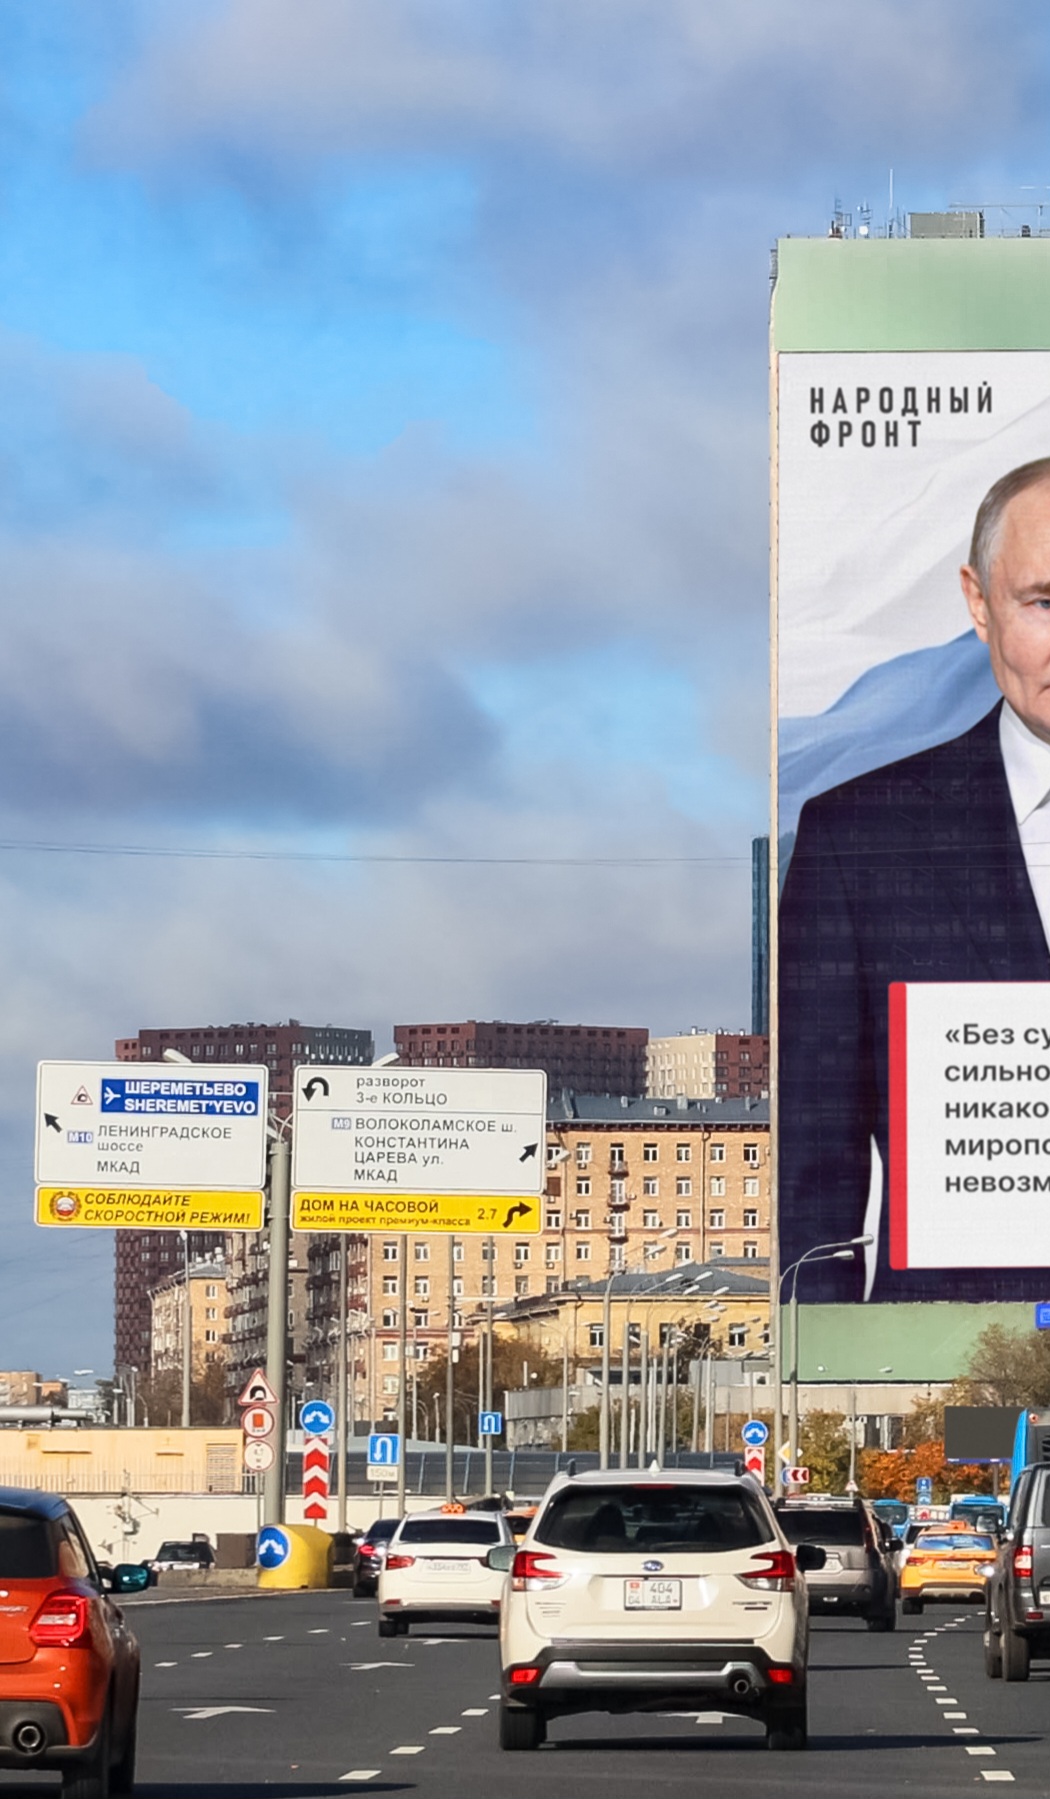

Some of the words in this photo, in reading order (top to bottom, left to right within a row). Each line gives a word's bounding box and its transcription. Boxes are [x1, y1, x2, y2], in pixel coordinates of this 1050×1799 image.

[810, 381, 994, 416] НАРОДНЫЙ
[810, 420, 922, 448] ФРОНТ
[945, 1023, 1015, 1045] «Без
[125, 1081, 246, 1096] ШЕРЕМЕТЬЕВО
[356, 1077, 426, 1090] разворот
[356, 1092, 378, 1104] 3-е
[383, 1093, 448, 1106] КОЛЬЦО
[98, 1125, 232, 1140] ЛЕНИНГРАДСКОЕ
[355, 1118, 497, 1133] ВОЛОКОЛАМСКОЕ
[97, 1142, 144, 1152] шоссе
[355, 1136, 470, 1150] КОНСТАНТИНА
[354, 1151, 418, 1164] ЦАРЕВА
[97, 1160, 140, 1174] МКАД
[354, 1169, 398, 1183] МКАД
[84, 1192, 191, 1207] СОБЛЮДАЙТЕ
[300, 1199, 335, 1213] ДОМ
[339, 1200, 360, 1212] НА
[364, 1199, 439, 1213] ЧАСОВОЙ
[84, 1209, 186, 1223] СКОРОСТНОЙ
[190, 1211, 250, 1225] РЕЖИМ!
